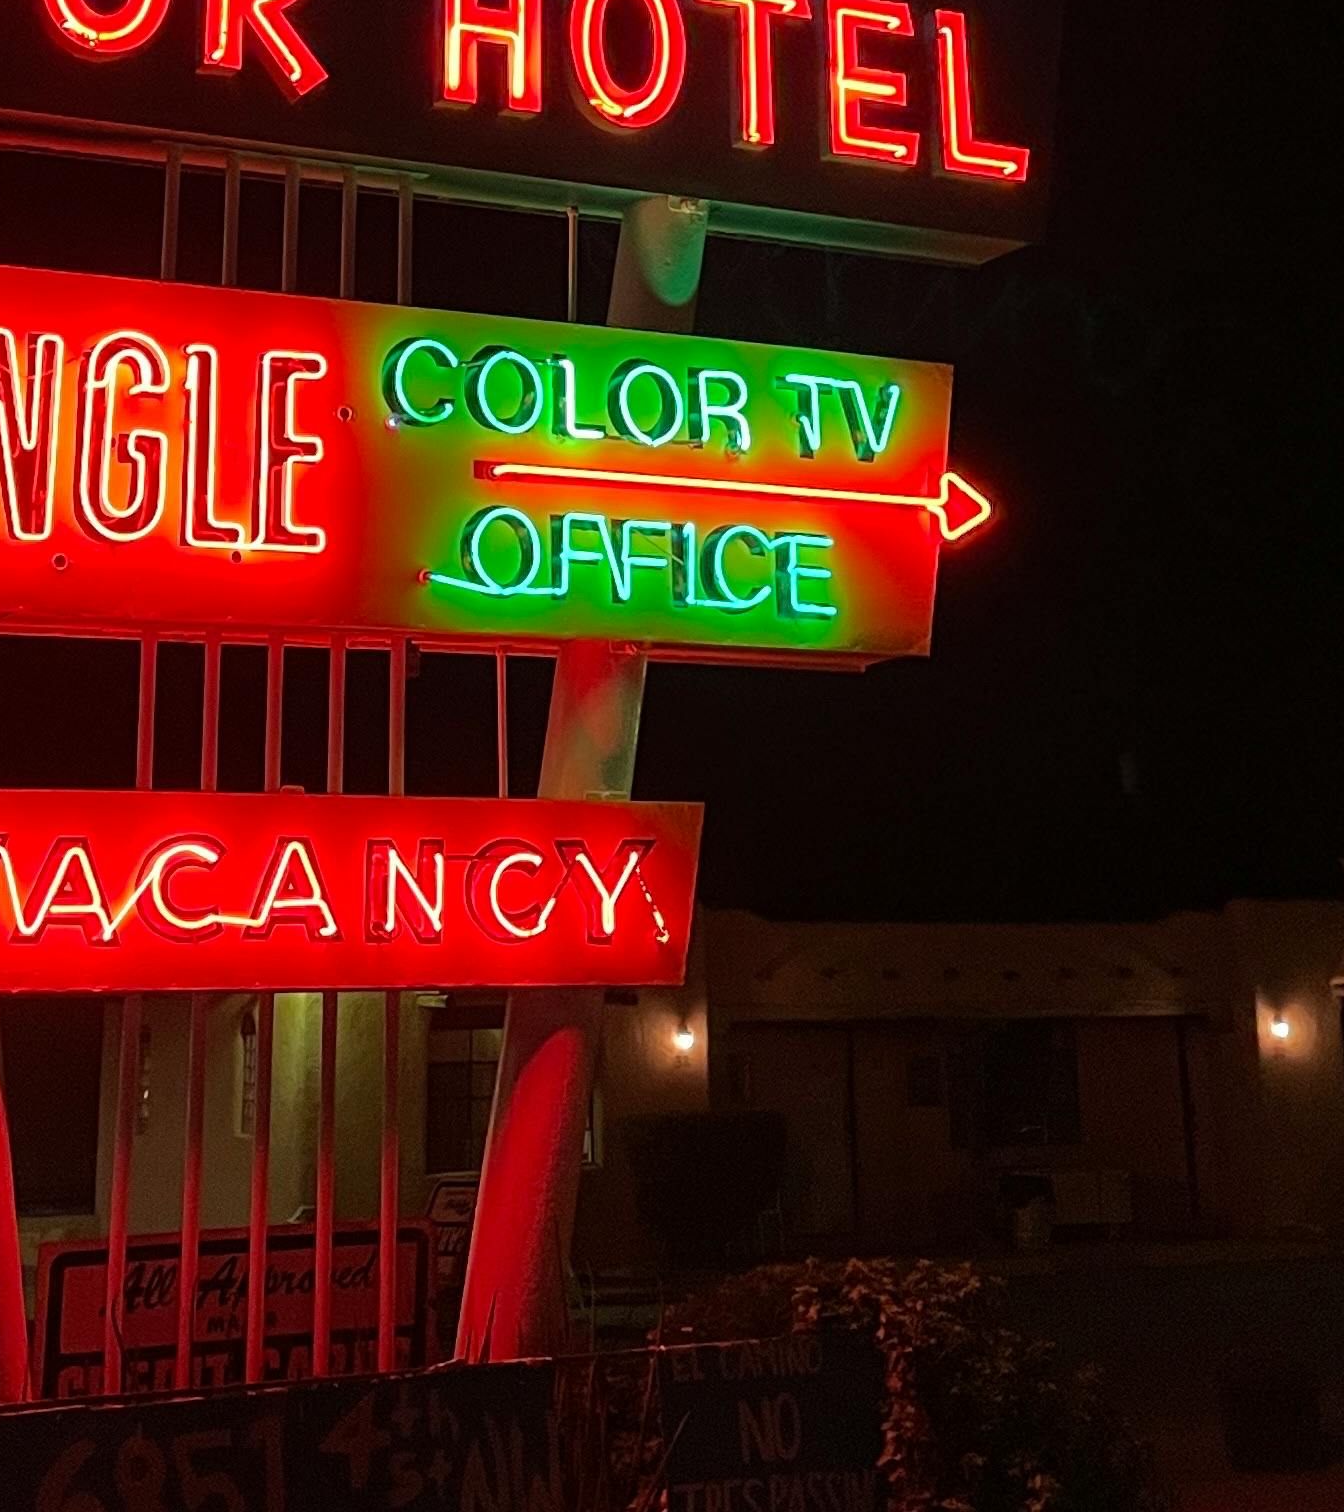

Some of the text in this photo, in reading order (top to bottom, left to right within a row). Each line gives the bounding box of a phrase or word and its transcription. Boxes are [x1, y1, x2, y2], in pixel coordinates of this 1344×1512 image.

[382, 335, 901, 462] COLOR TV
[459, 504, 837, 621] OFFICE
[718, 1339, 824, 1380] CAMINO
[737, 1391, 803, 1464] NO
